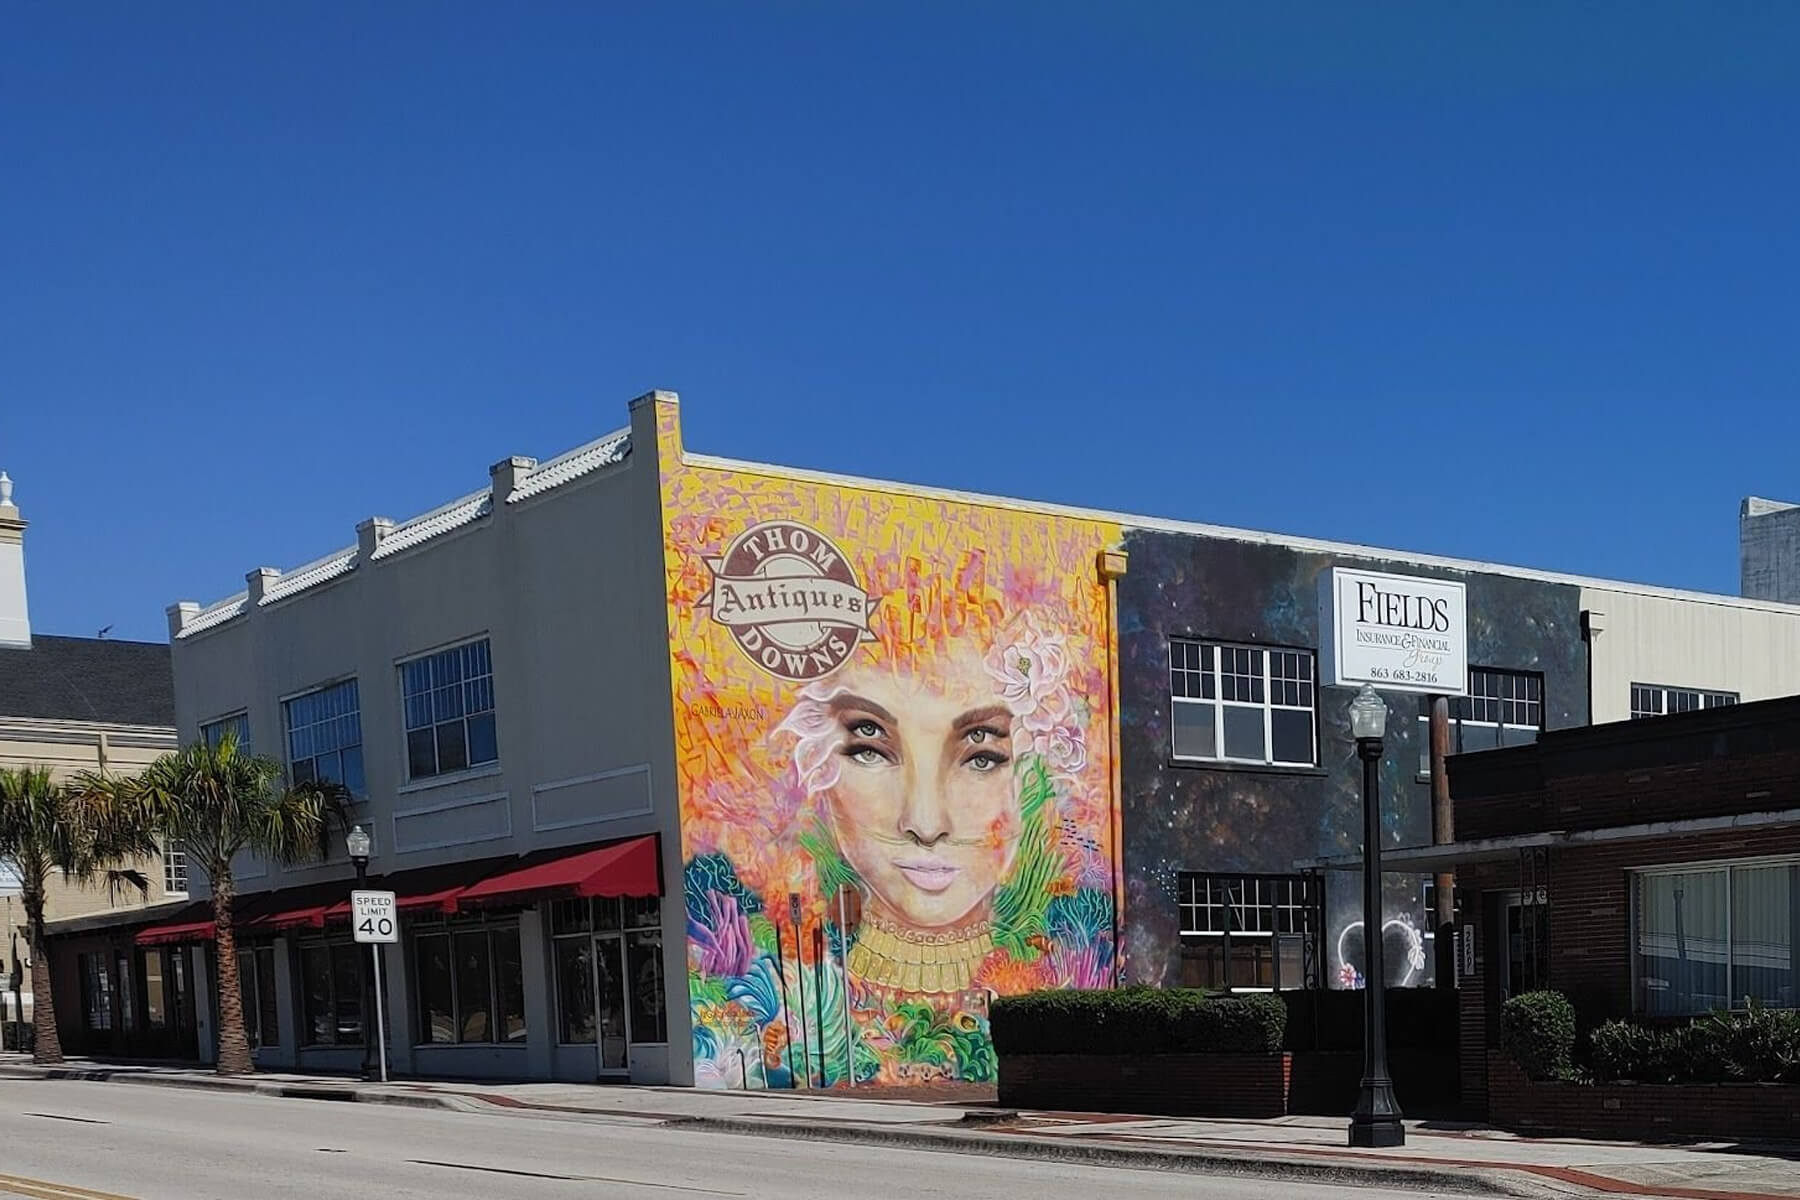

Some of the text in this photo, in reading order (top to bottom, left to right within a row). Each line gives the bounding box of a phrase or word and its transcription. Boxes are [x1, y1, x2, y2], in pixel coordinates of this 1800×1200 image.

[742, 527, 838, 574] THOM
[717, 583, 863, 621] Antiques
[1355, 581, 1449, 632] FIELDS
[739, 628, 848, 676] DOWNS
[1356, 629, 1401, 646] INSURANCE
[1411, 635, 1450, 652] FINANCIAL
[1370, 667, 1438, 683] 863 683-2816
[356, 897, 391, 906] SPEED
[361, 907, 388, 916] LIMIT
[358, 917, 393, 936] 40
